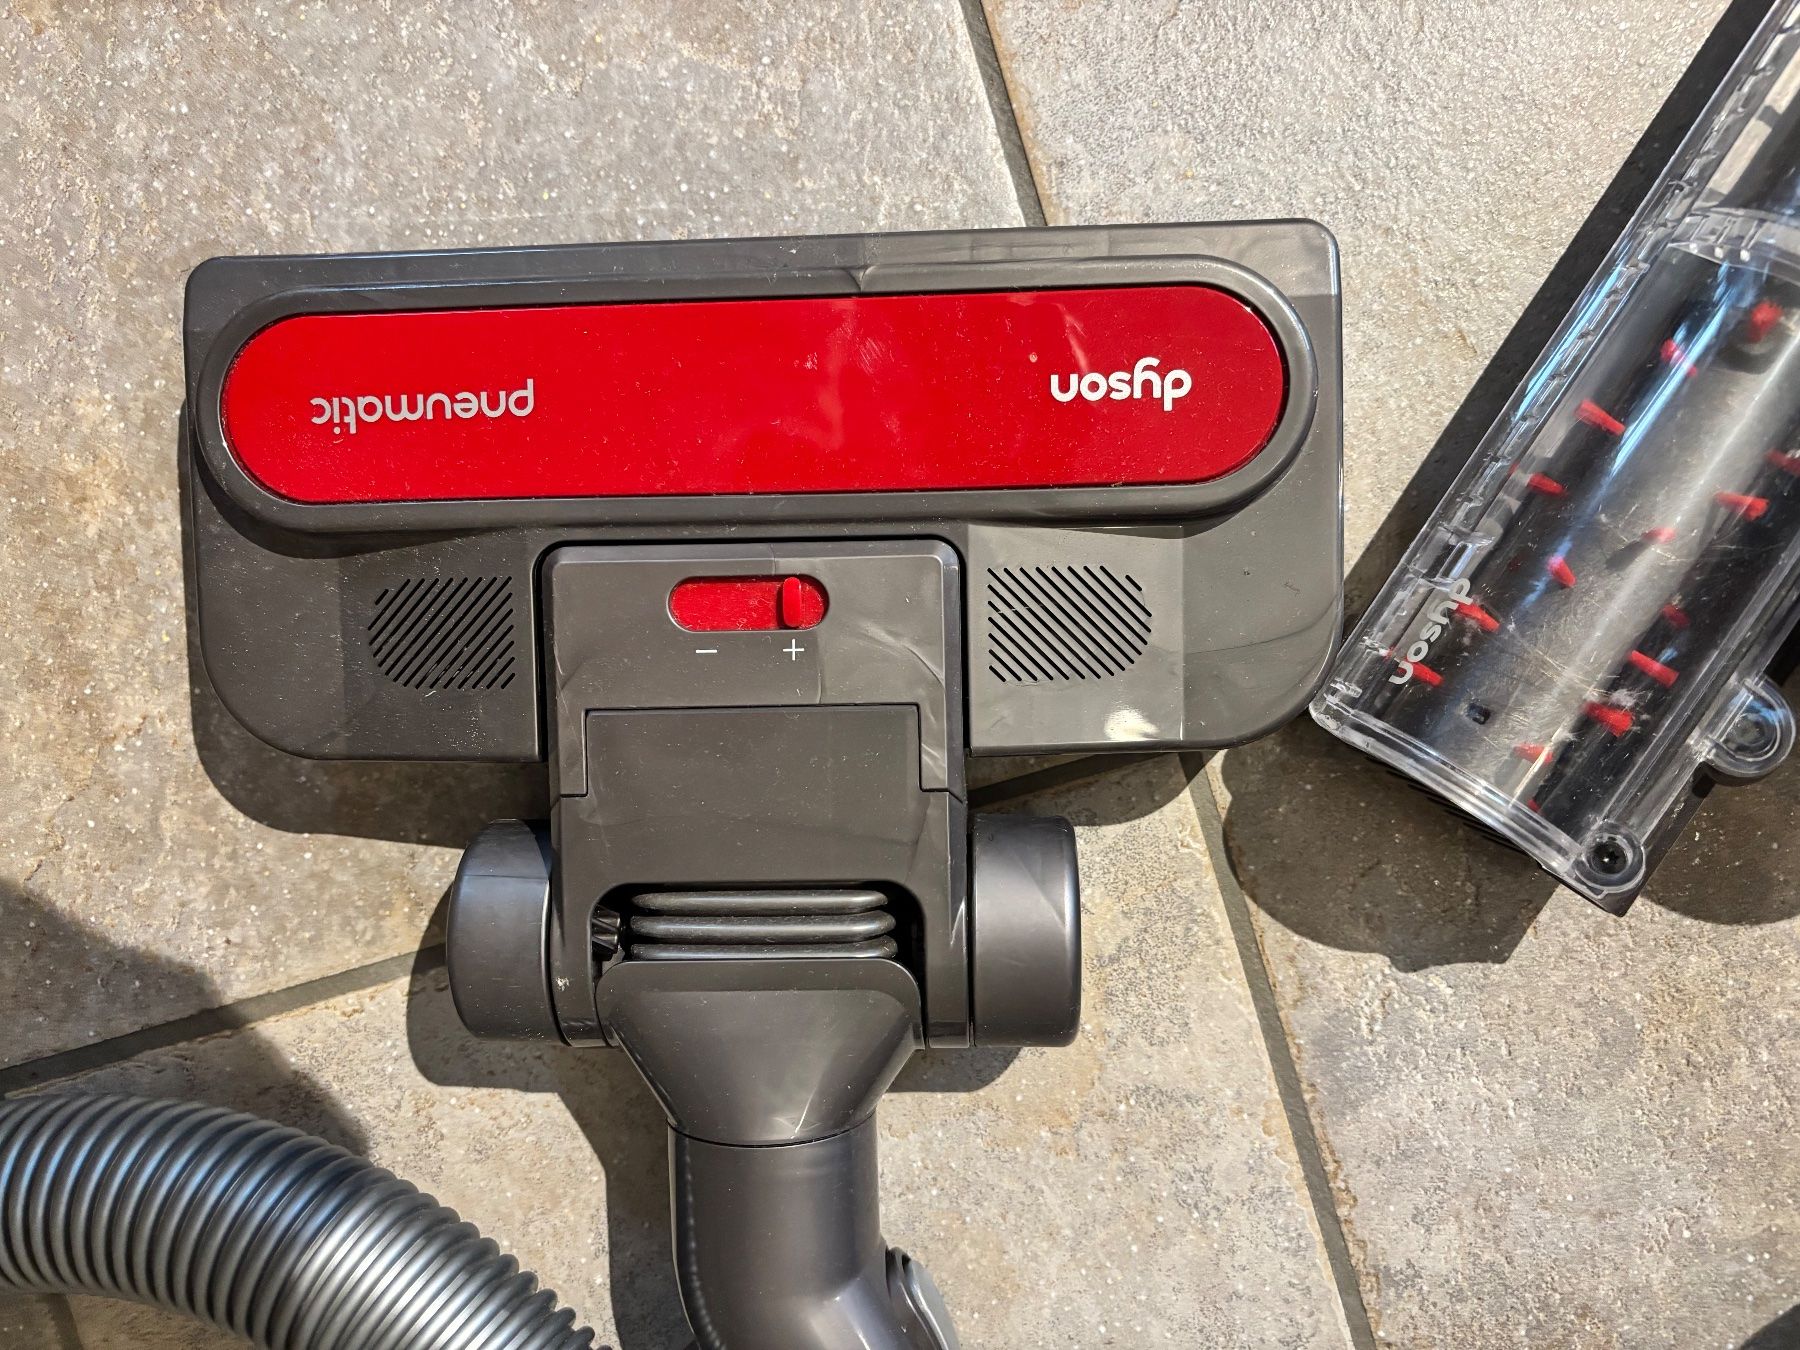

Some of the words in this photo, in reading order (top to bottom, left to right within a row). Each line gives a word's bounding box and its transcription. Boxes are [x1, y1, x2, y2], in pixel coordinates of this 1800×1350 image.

[310, 379, 535, 434] pneumatic
[1050, 357, 1192, 411] dyson
[1388, 578, 1474, 685] dyson
